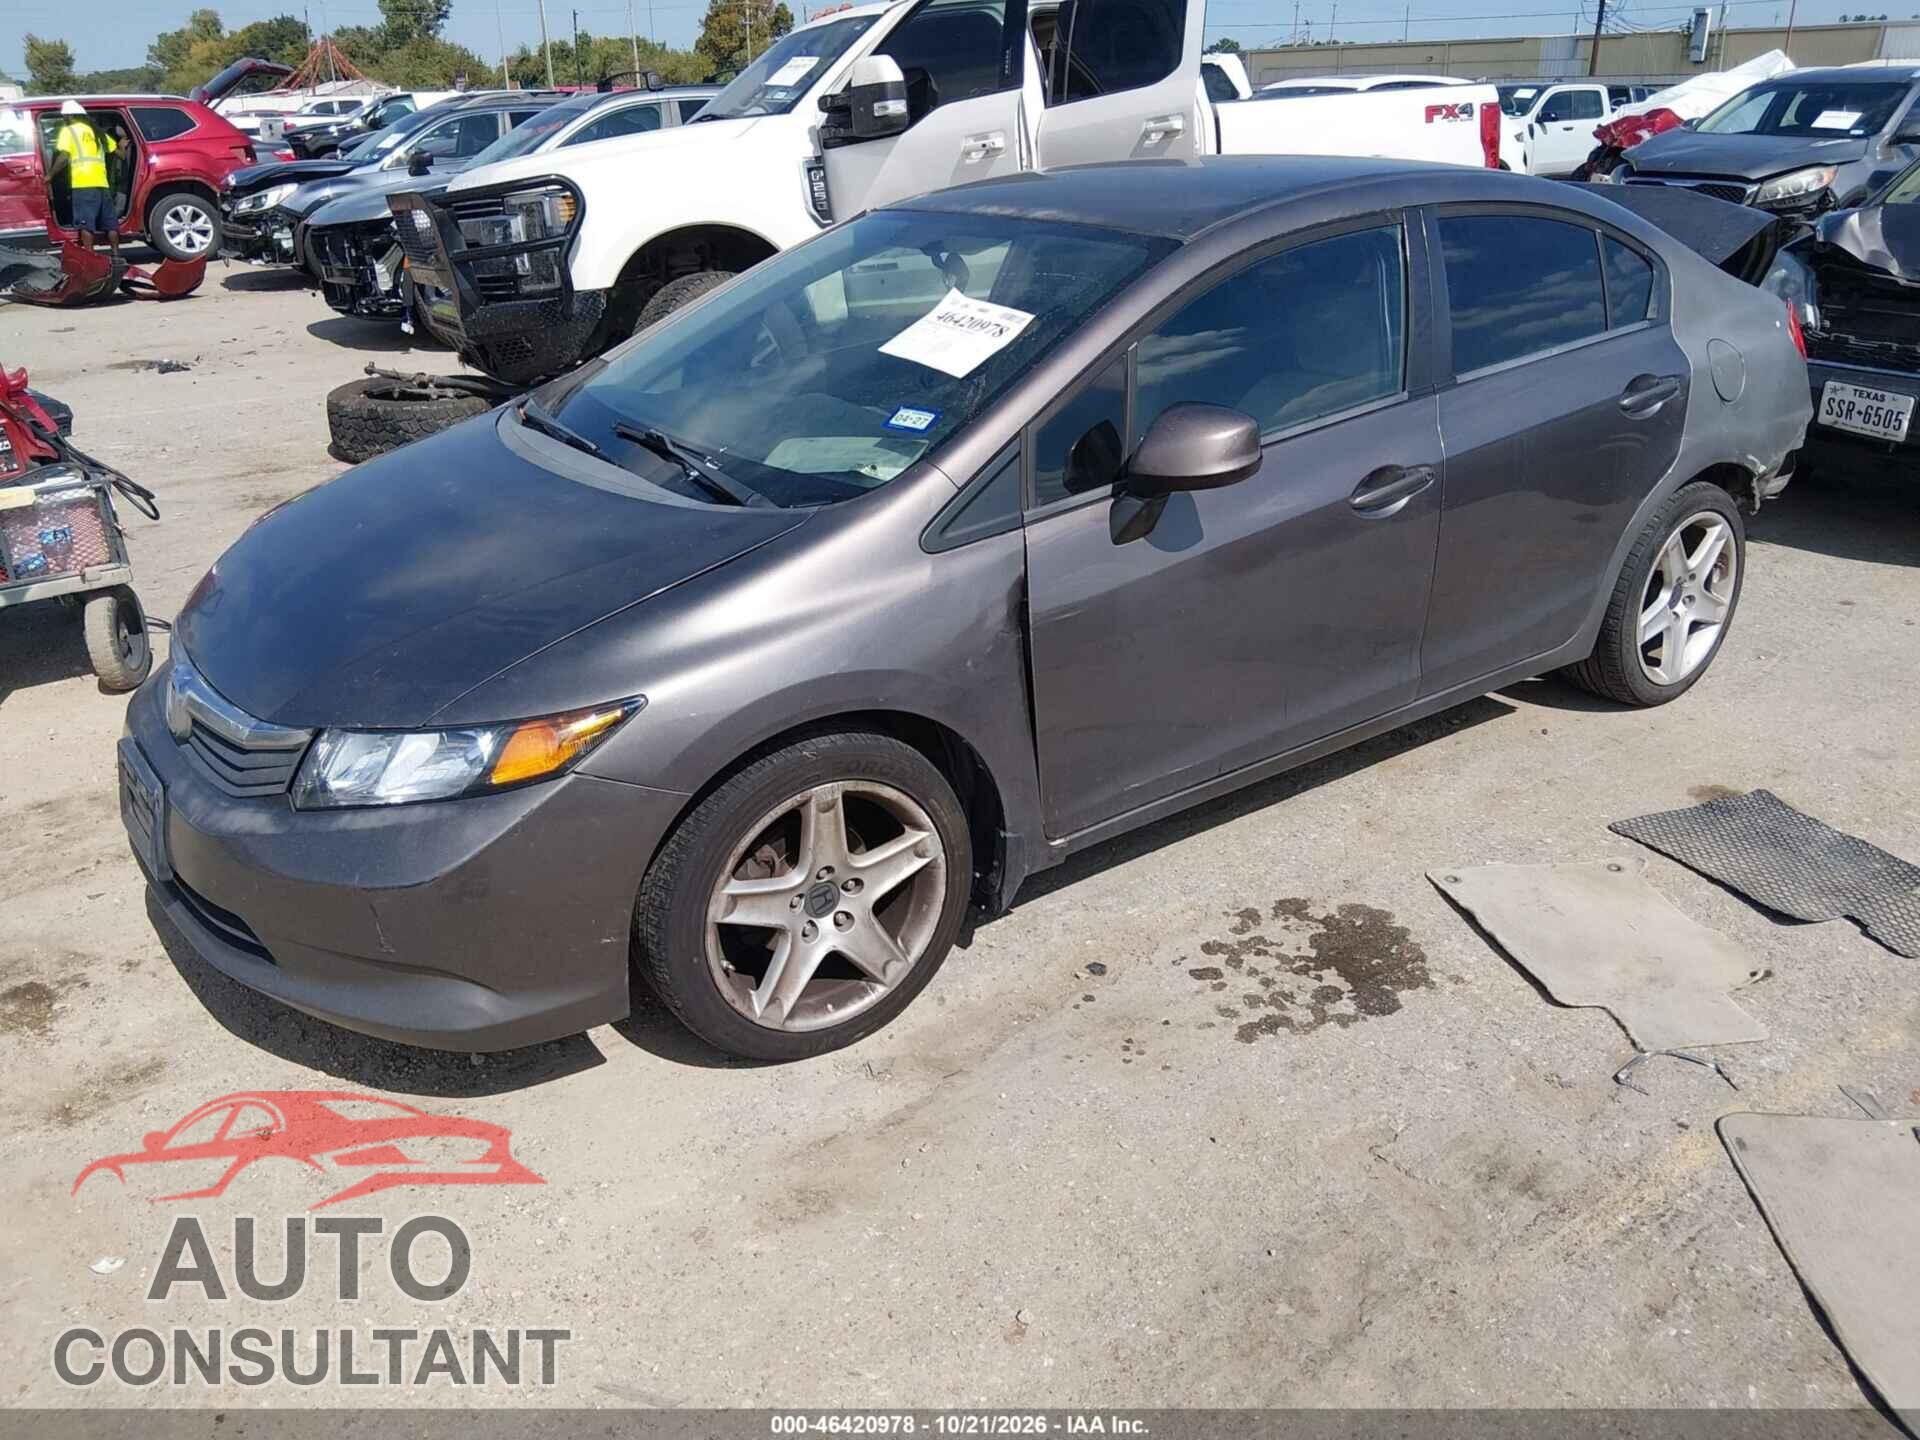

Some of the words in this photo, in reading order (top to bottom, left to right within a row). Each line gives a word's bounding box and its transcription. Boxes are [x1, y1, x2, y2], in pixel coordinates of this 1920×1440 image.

[1425, 102, 1474, 123] FX4
[936, 311, 1010, 338] 46420978
[1853, 388, 1887, 403] TEXAS
